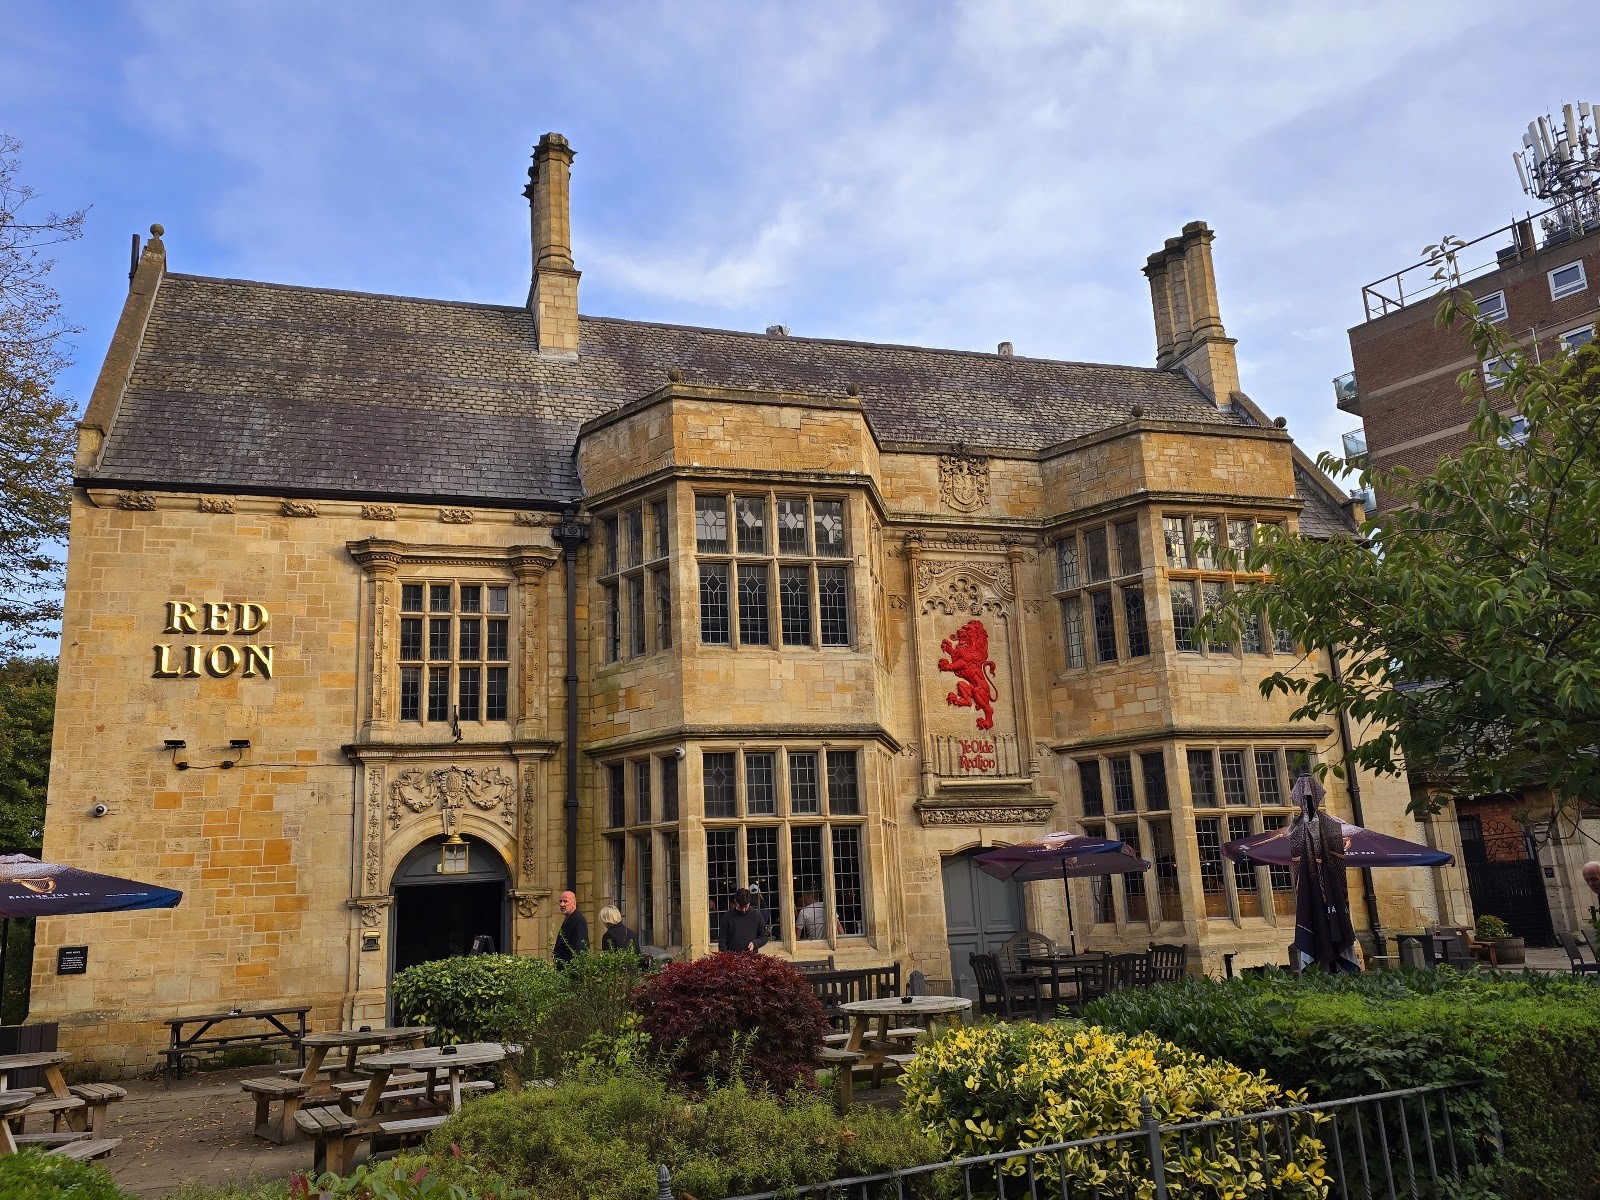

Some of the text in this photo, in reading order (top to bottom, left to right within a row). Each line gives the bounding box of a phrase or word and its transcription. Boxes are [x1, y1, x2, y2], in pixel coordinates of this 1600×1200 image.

[163, 600, 269, 635] RED
[151, 643, 275, 680] LION
[959, 739, 994, 756] Ye Olde
